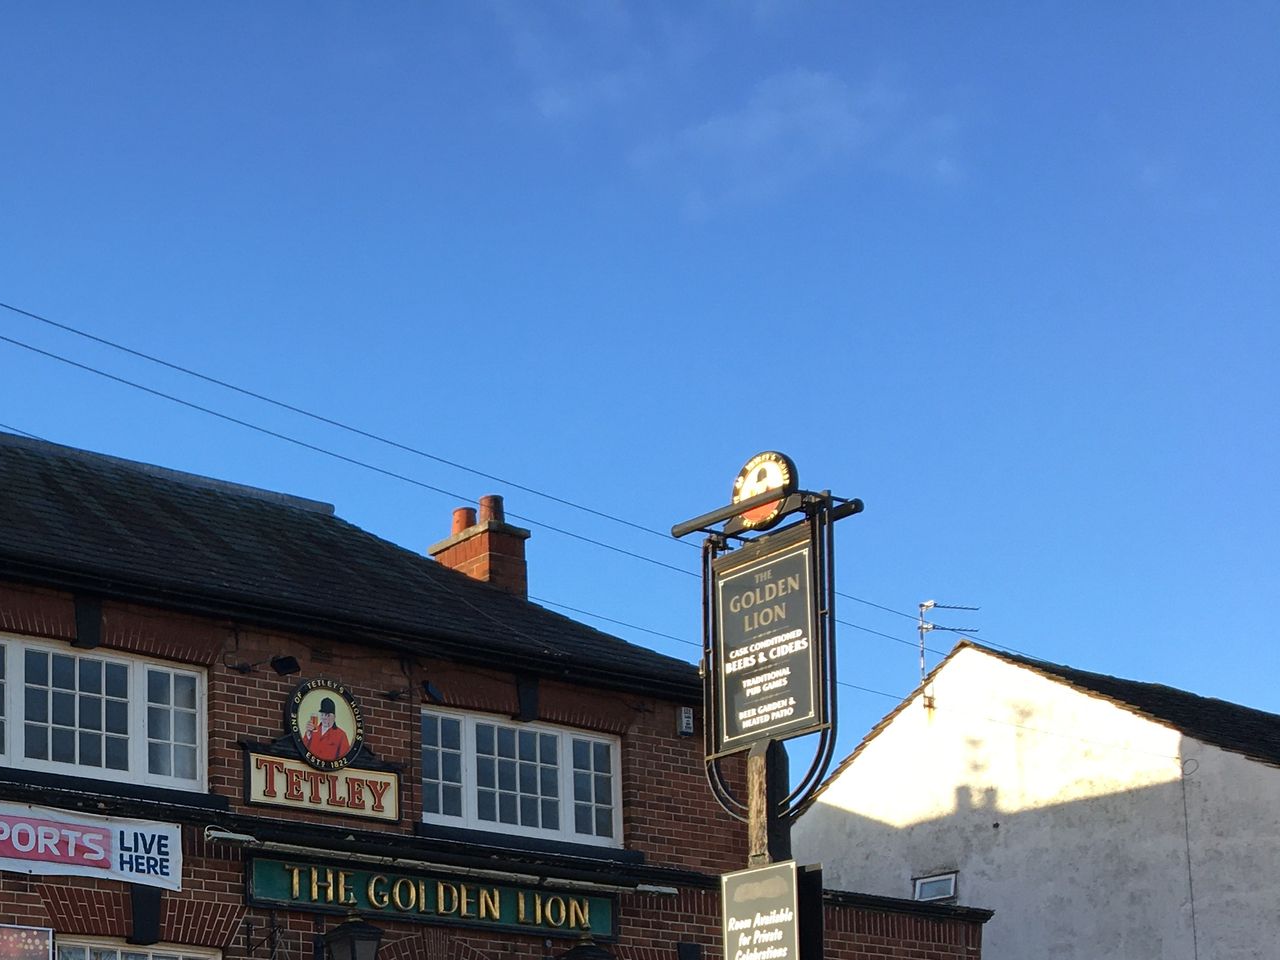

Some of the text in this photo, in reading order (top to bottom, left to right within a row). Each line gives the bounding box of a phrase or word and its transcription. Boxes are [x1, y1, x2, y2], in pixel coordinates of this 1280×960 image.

[754, 569, 772, 583] THE
[730, 573, 800, 613] GOLDEN
[744, 602, 786, 632] LION
[725, 637, 808, 674] BEERS & CIDERS
[729, 628, 803, 659] CASK CONDITIONED
[742, 666, 791, 688] TRADITIONAL
[746, 677, 788, 697] PUB GAMES
[290, 679, 364, 741] ONE OF TETLEY'S HOUSES
[739, 696, 796, 720] BEER GARDEN &
[742, 707, 793, 729] HEATED PATIO
[330, 757, 348, 769] 1822
[255, 758, 391, 812] TETLEY
[119, 830, 170, 857] LIVE
[119, 852, 170, 877] HERE
[284, 863, 591, 929] THE GOLDEN LION
[728, 907, 793, 932] Room Available
[738, 928, 783, 947] for Private
